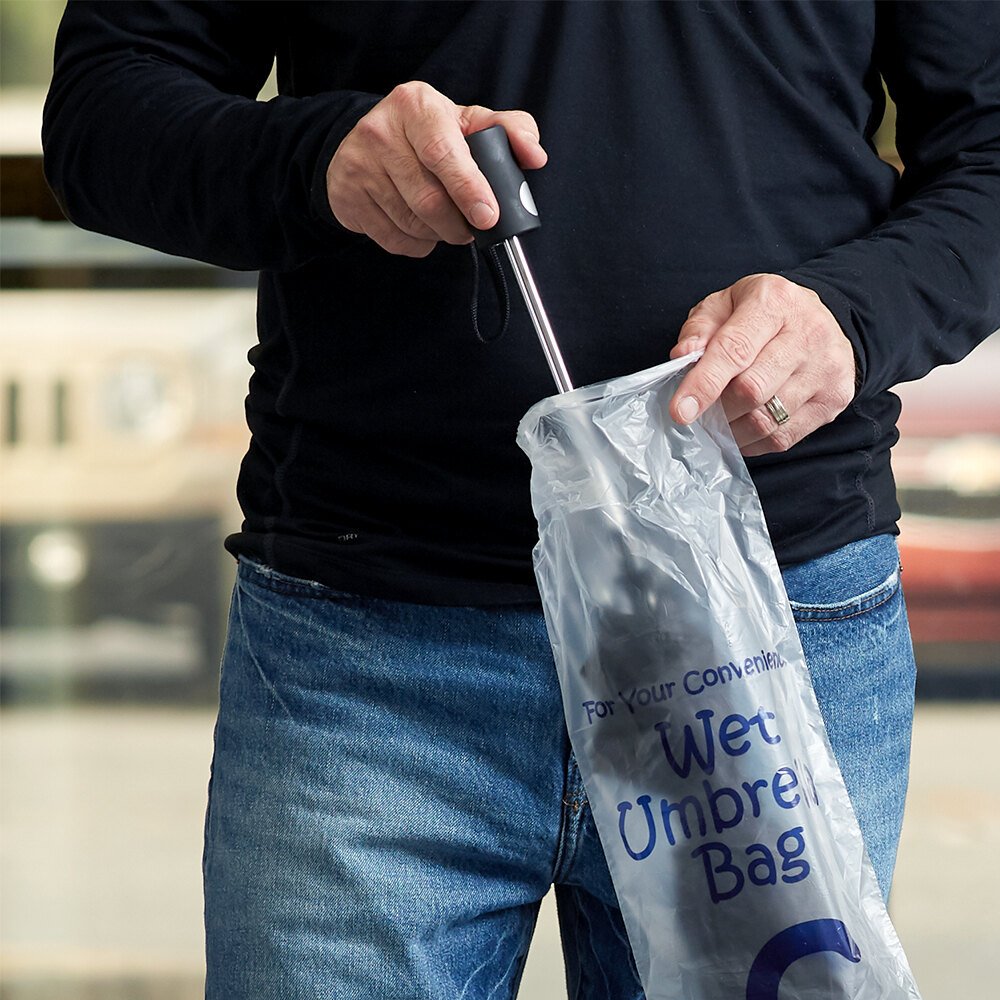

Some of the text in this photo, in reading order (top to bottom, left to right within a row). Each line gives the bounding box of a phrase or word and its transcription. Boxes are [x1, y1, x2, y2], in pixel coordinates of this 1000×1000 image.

[582, 698, 615, 724] For
[618, 681, 676, 714] Your
[654, 706, 781, 779] Wet
[691, 826, 811, 904] Bag
